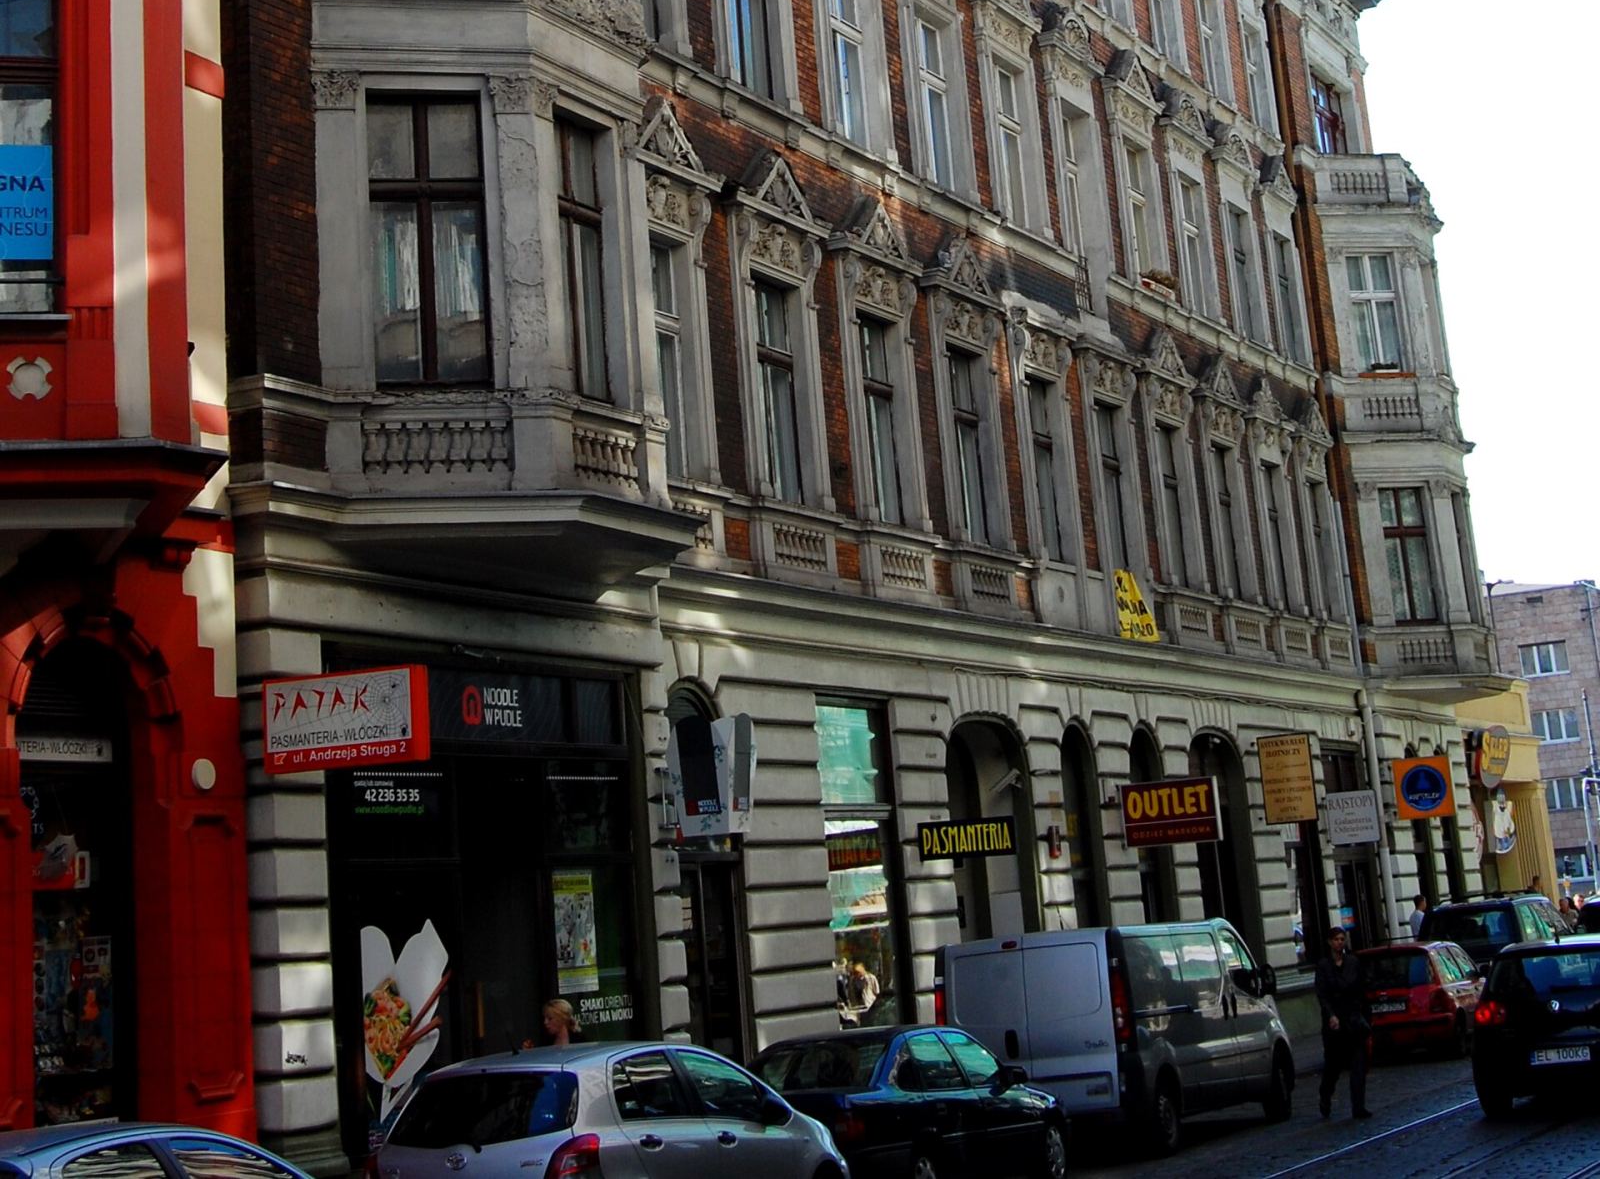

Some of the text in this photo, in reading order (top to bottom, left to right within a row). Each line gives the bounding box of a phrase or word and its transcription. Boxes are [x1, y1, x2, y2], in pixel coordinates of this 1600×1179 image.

[0, 206, 48, 219] TRUM
[483, 687, 519, 707] NOODLE
[293, 741, 407, 764] ul. Andrzeja Struga 2
[364, 789, 421, 802] 42 236 35 35
[1126, 784, 1209, 820] OUTLET
[1328, 794, 1374, 812] RAJSTOPY
[921, 822, 1013, 856] PASMANTERIA
[580, 994, 633, 1012] SMAKI ORIENTU
[599, 1010, 611, 1022] NA
[611, 1008, 634, 1021] WOKU
[1536, 1047, 1589, 1062] EL 100KG
